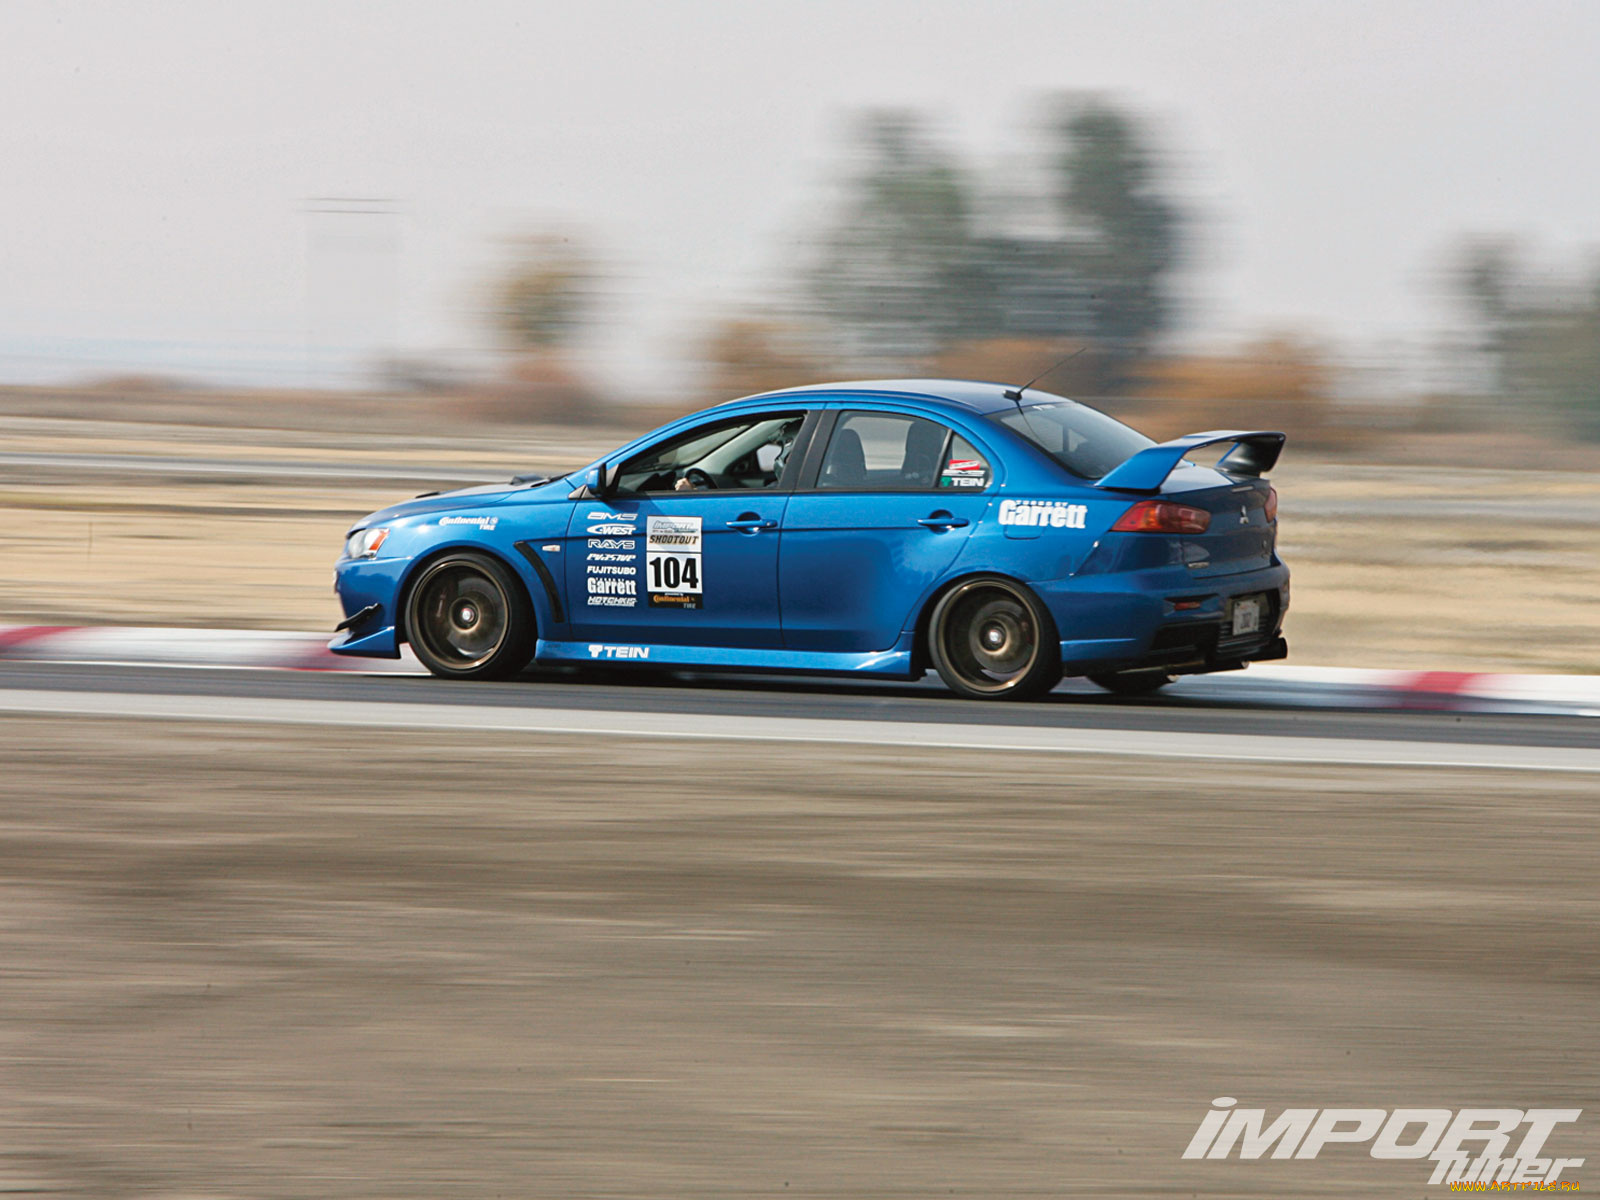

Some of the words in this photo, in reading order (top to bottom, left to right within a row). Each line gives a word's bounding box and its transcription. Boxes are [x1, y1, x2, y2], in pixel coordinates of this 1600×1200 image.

[952, 478, 985, 487] TEIN
[998, 500, 1088, 529] Garrett
[439, 516, 490, 526] Continental
[588, 539, 636, 550] RAYS
[649, 535, 699, 545] SHOOTOUT
[587, 565, 637, 575] FUJITSUBO
[649, 556, 699, 589] 104
[587, 577, 637, 595] Garrett
[653, 594, 690, 603] Continental
[604, 646, 650, 659] TEIN
